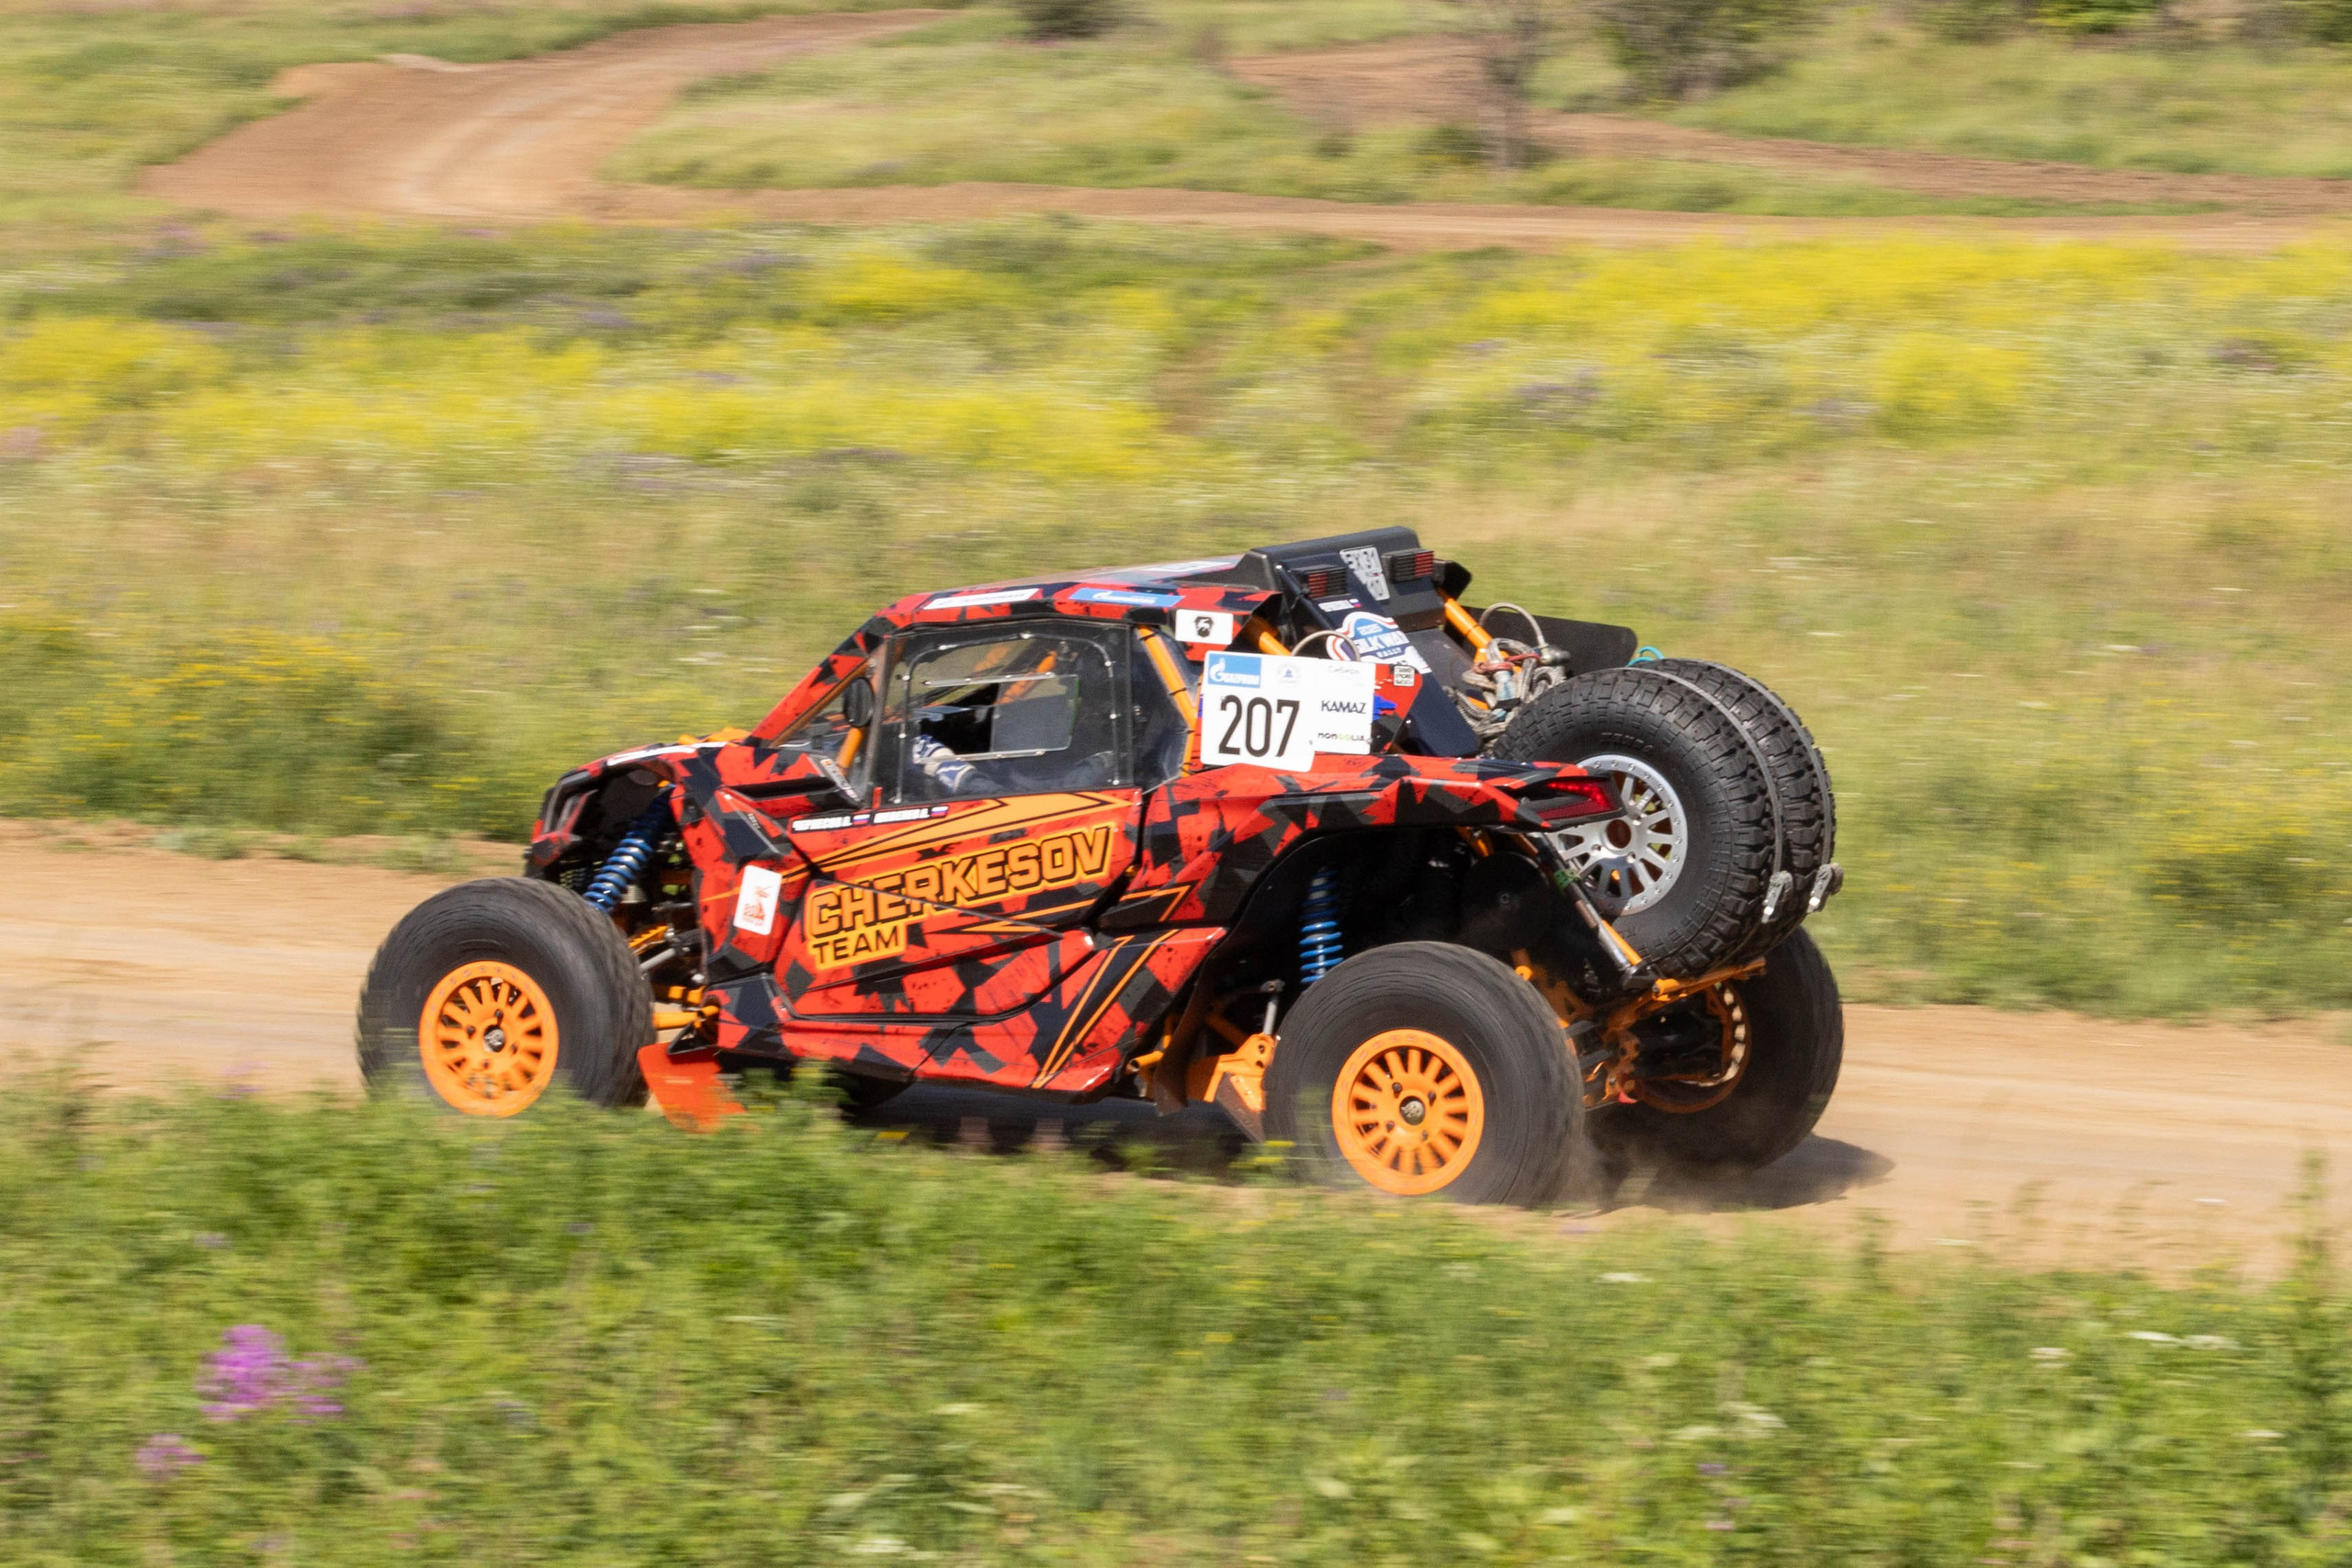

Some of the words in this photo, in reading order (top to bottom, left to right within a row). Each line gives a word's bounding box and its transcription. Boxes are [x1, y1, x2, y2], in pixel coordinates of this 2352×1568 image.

[1376, 647, 1403, 659] RALLY
[1218, 694, 1300, 758] 207
[1320, 699, 1367, 715] KAMAZ
[810, 825, 1111, 939] CHERKESOV
[812, 924, 900, 964] TEAM
